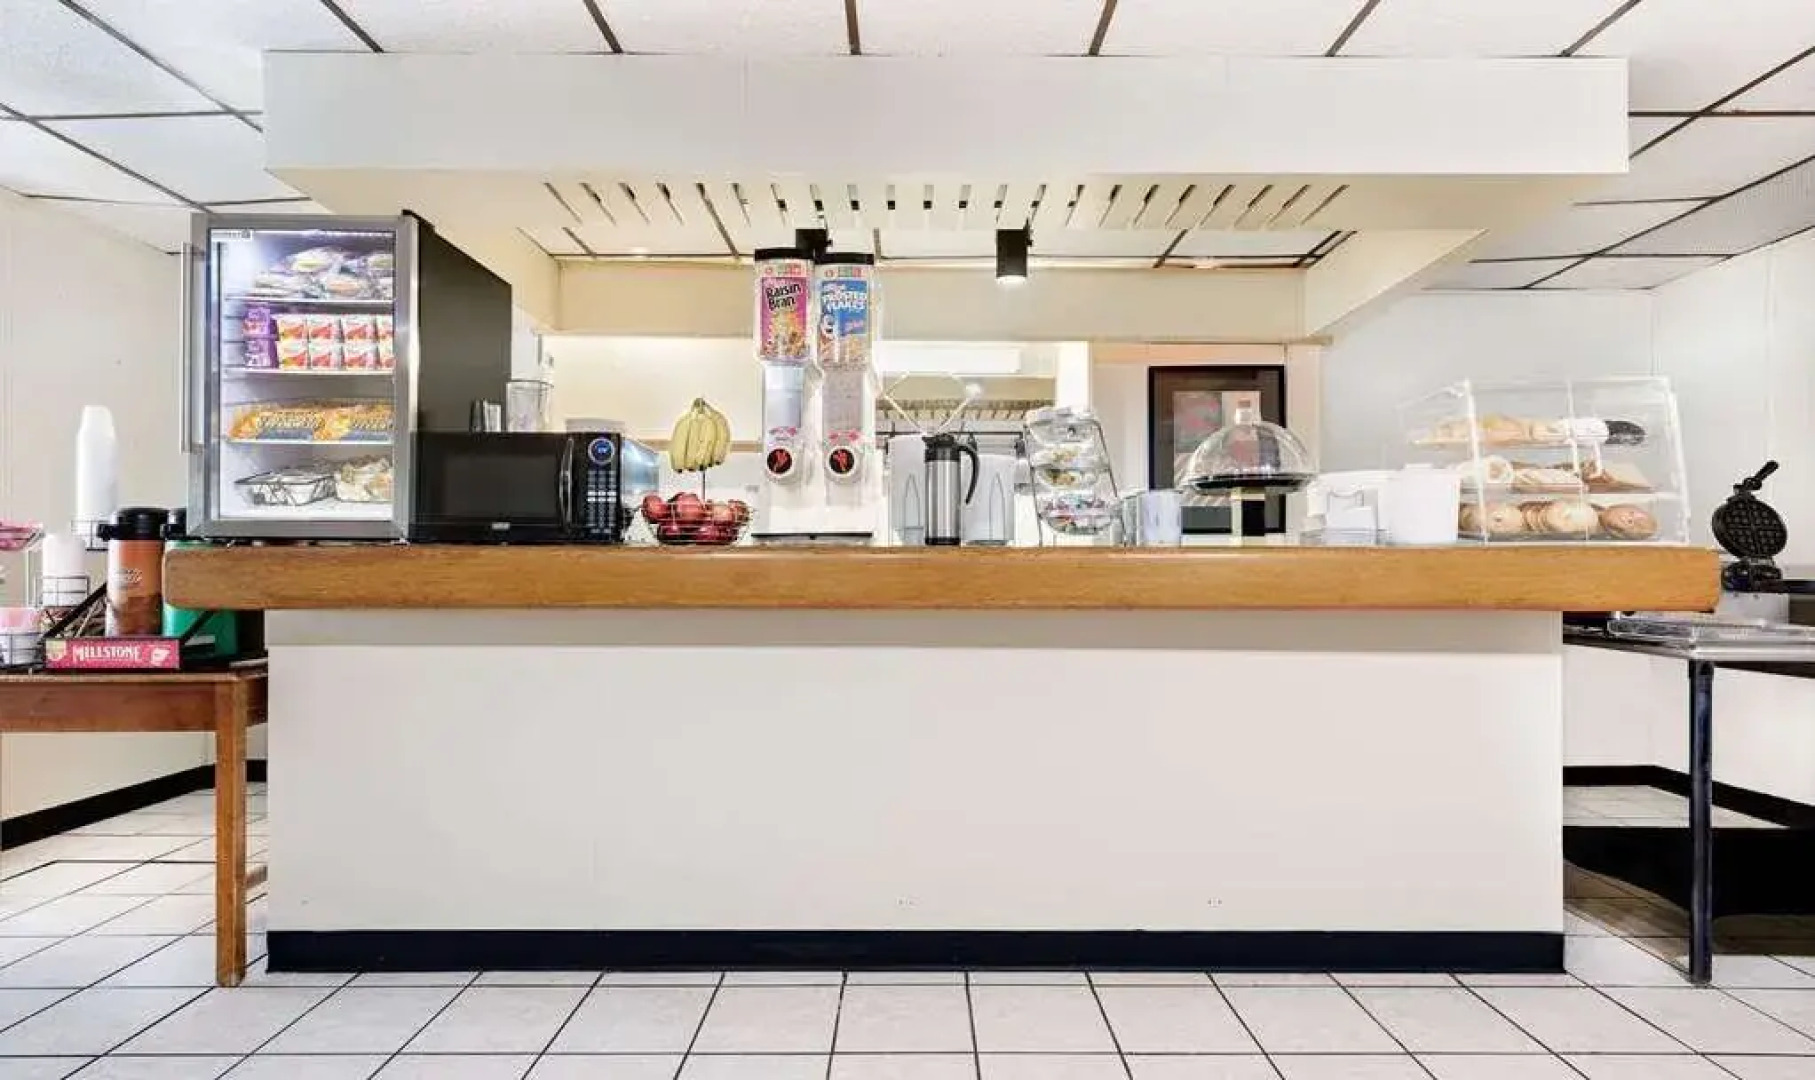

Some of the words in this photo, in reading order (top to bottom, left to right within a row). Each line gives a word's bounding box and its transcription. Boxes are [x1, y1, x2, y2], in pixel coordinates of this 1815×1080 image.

[766, 284, 801, 298] Raisin
[768, 297, 796, 311] Bran
[73, 645, 142, 662] MILLSTONE
